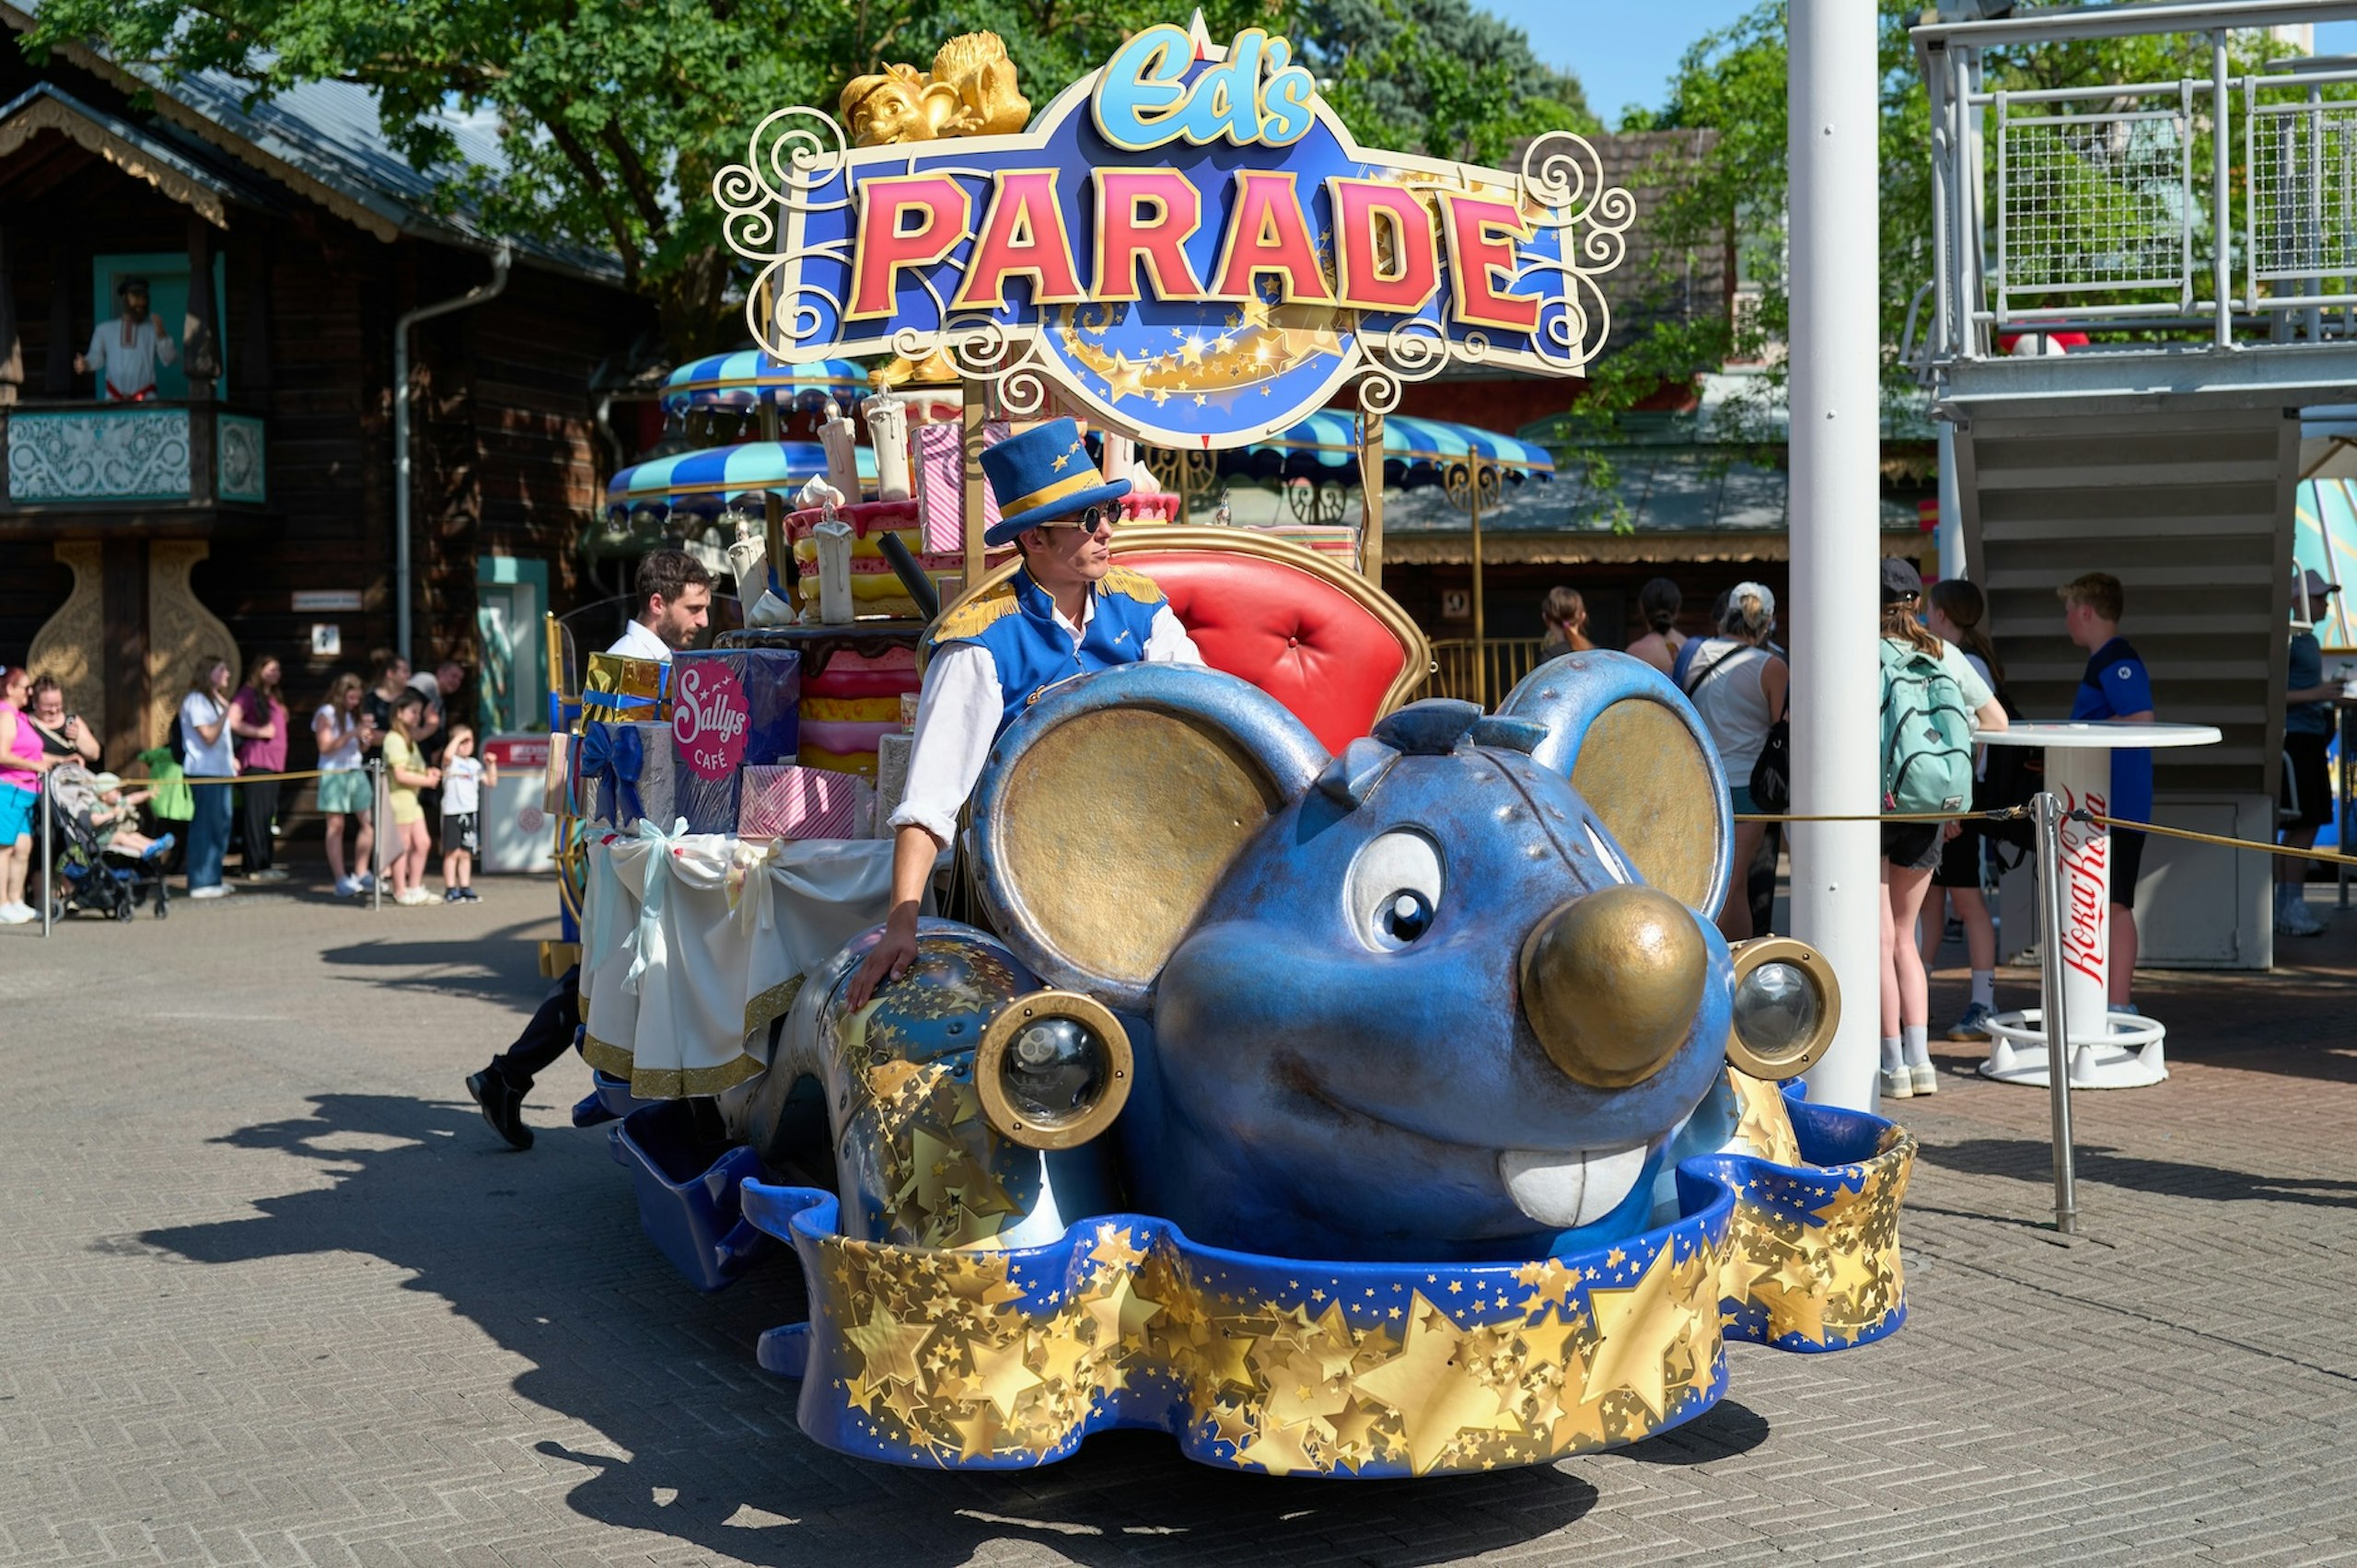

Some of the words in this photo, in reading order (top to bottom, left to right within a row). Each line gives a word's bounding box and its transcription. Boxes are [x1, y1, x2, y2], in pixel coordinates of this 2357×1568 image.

[1091, 22, 1316, 152] Ed's
[842, 167, 1544, 332] PARADE
[673, 668, 747, 744] Sallys
[694, 748, 728, 771] CAFÉ
